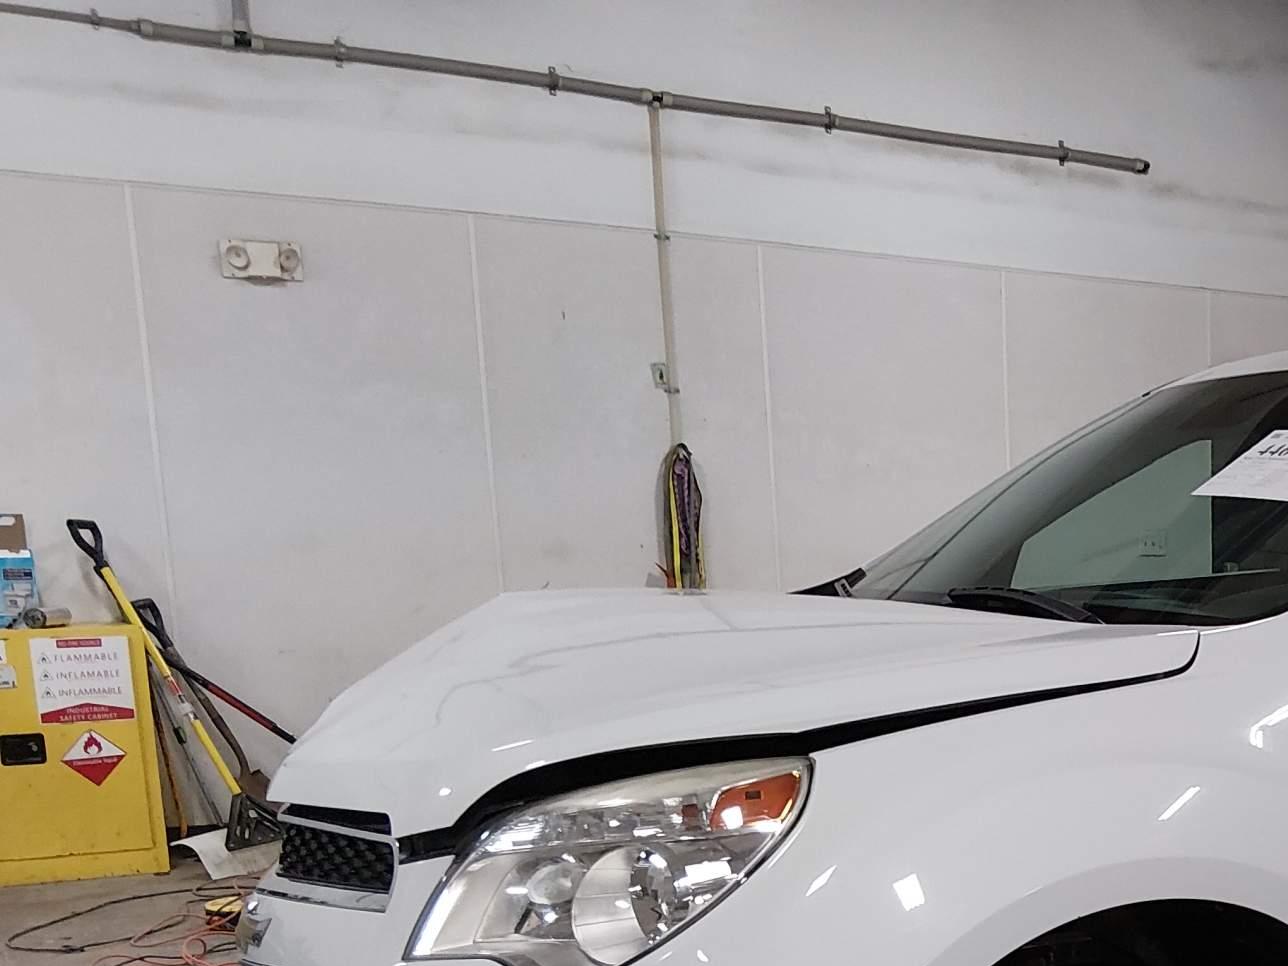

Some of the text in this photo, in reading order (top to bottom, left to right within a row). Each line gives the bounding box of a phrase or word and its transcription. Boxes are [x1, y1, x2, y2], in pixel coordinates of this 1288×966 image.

[54, 652, 118, 662] FLAMMABLE
[56, 669, 120, 680] INFLAMABLE
[58, 686, 122, 697] INFLAMMABLE
[87, 712, 118, 720] CABINET
